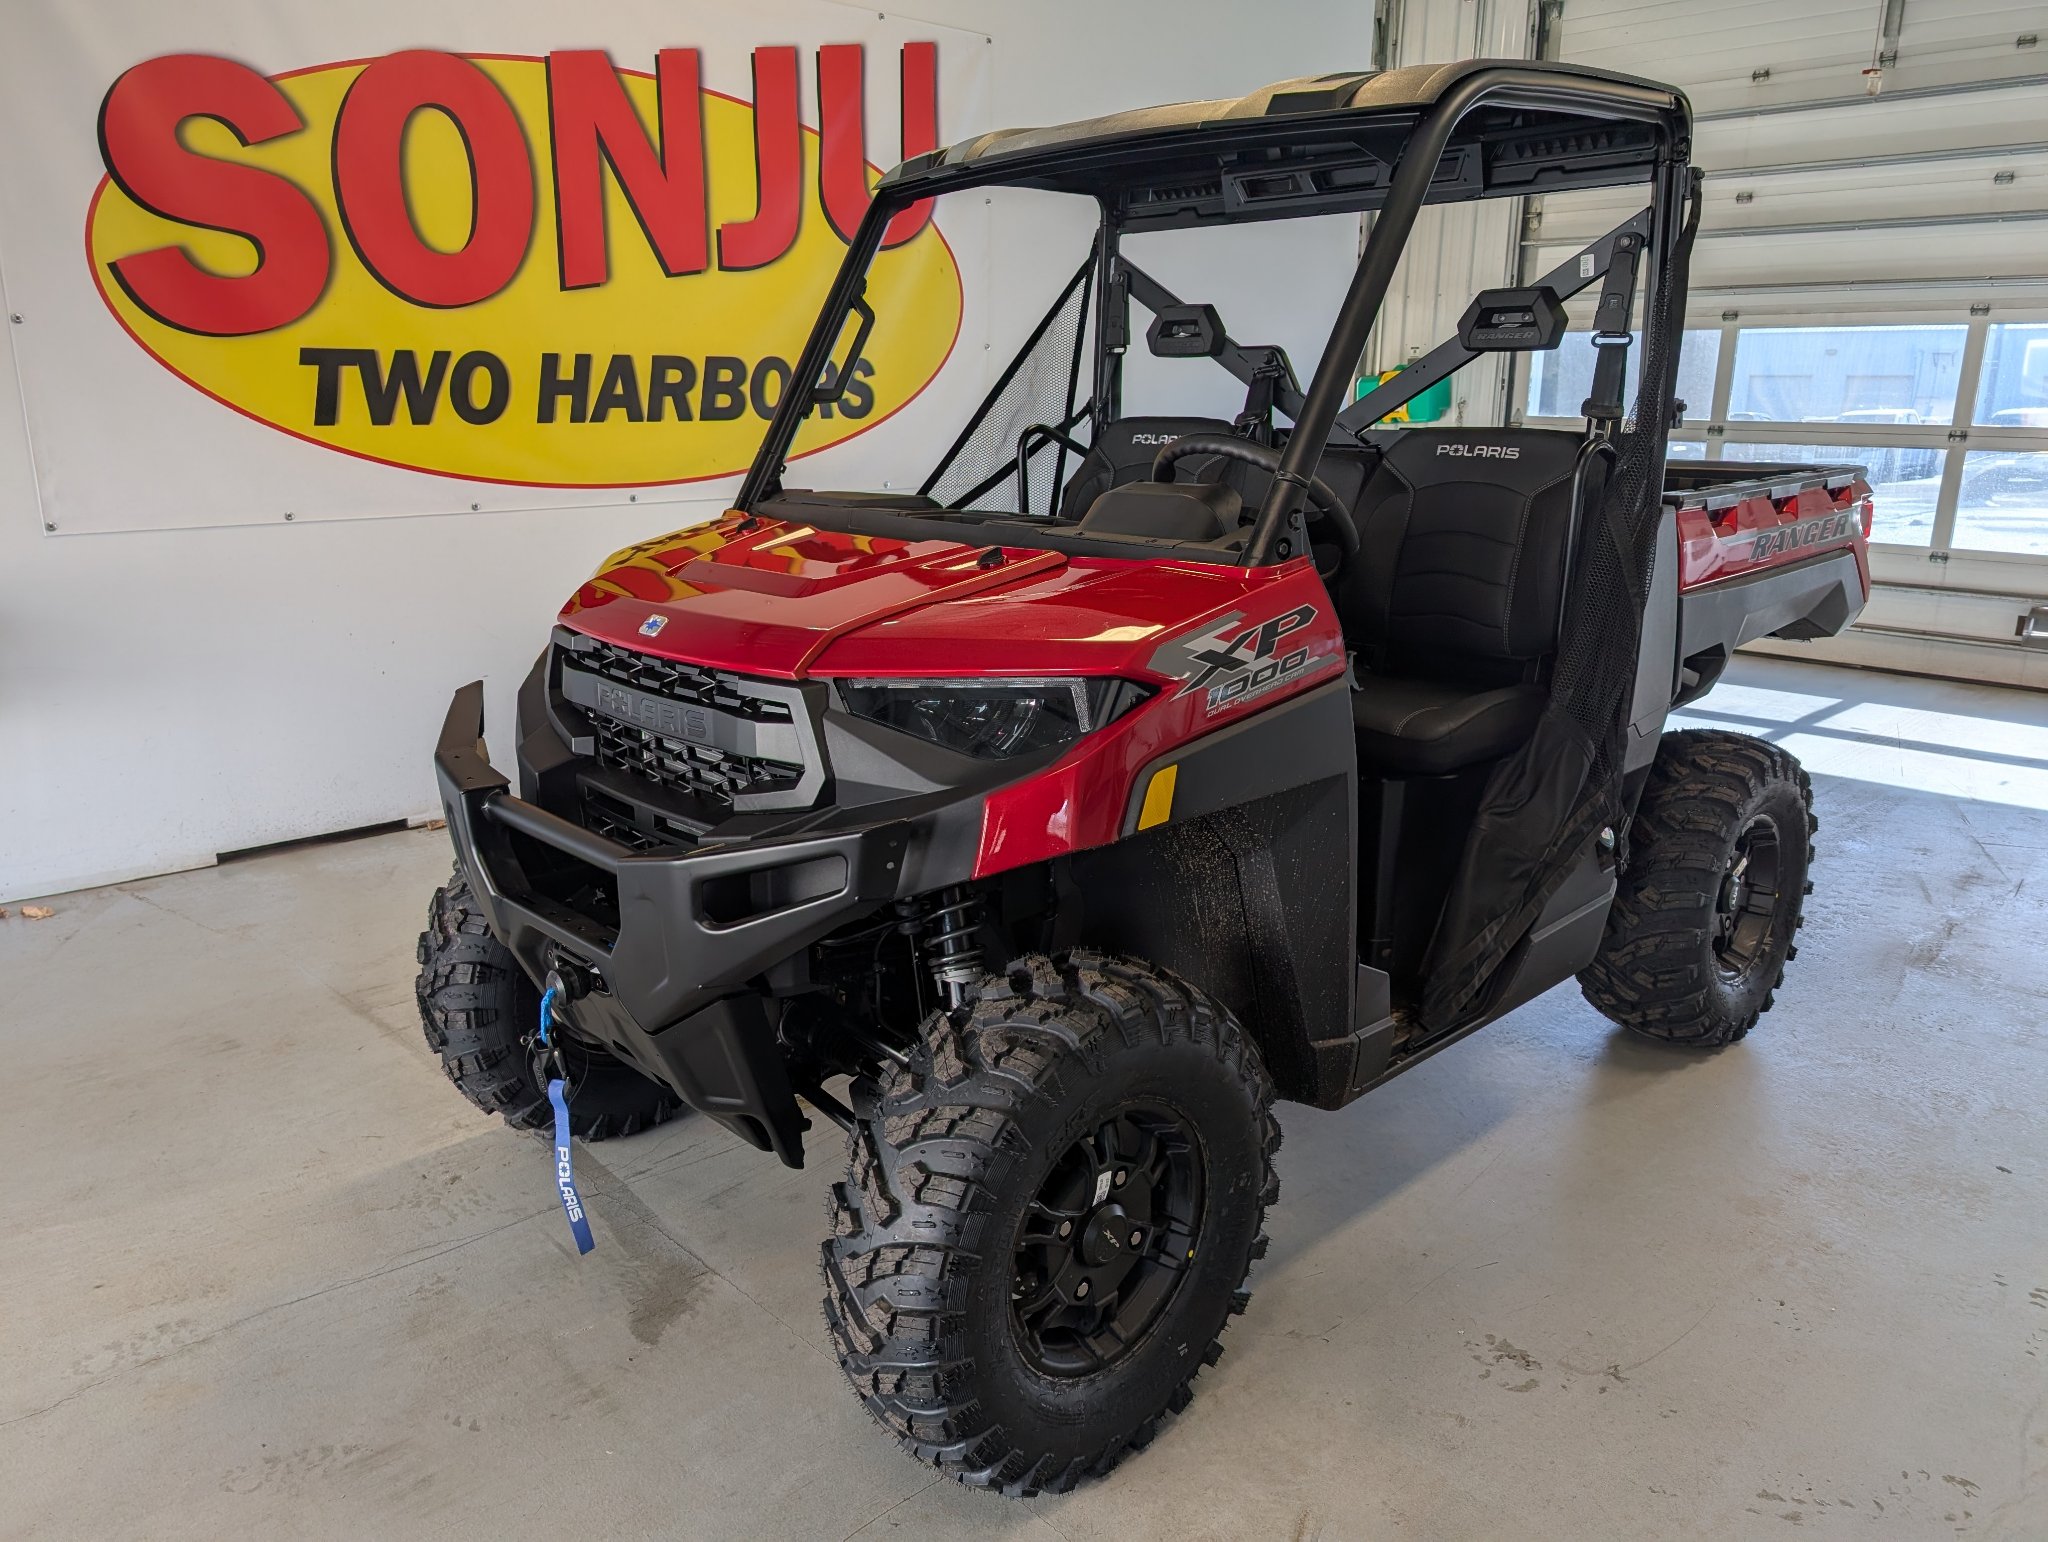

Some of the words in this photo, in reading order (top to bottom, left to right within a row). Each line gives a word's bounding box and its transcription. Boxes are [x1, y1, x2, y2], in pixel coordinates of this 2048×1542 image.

[98, 41, 937, 337] SONJU
[1476, 331, 1535, 340] RANGER
[300, 348, 510, 427] TWO
[1132, 434, 1181, 445] POLAR
[1436, 444, 1520, 459] POLARIS
[1748, 513, 1850, 562] RANGER
[1169, 603, 1319, 702] XP
[1206, 645, 1310, 711] 1000
[597, 682, 707, 739] POLARIS
[557, 1146, 583, 1223] POLARIS
